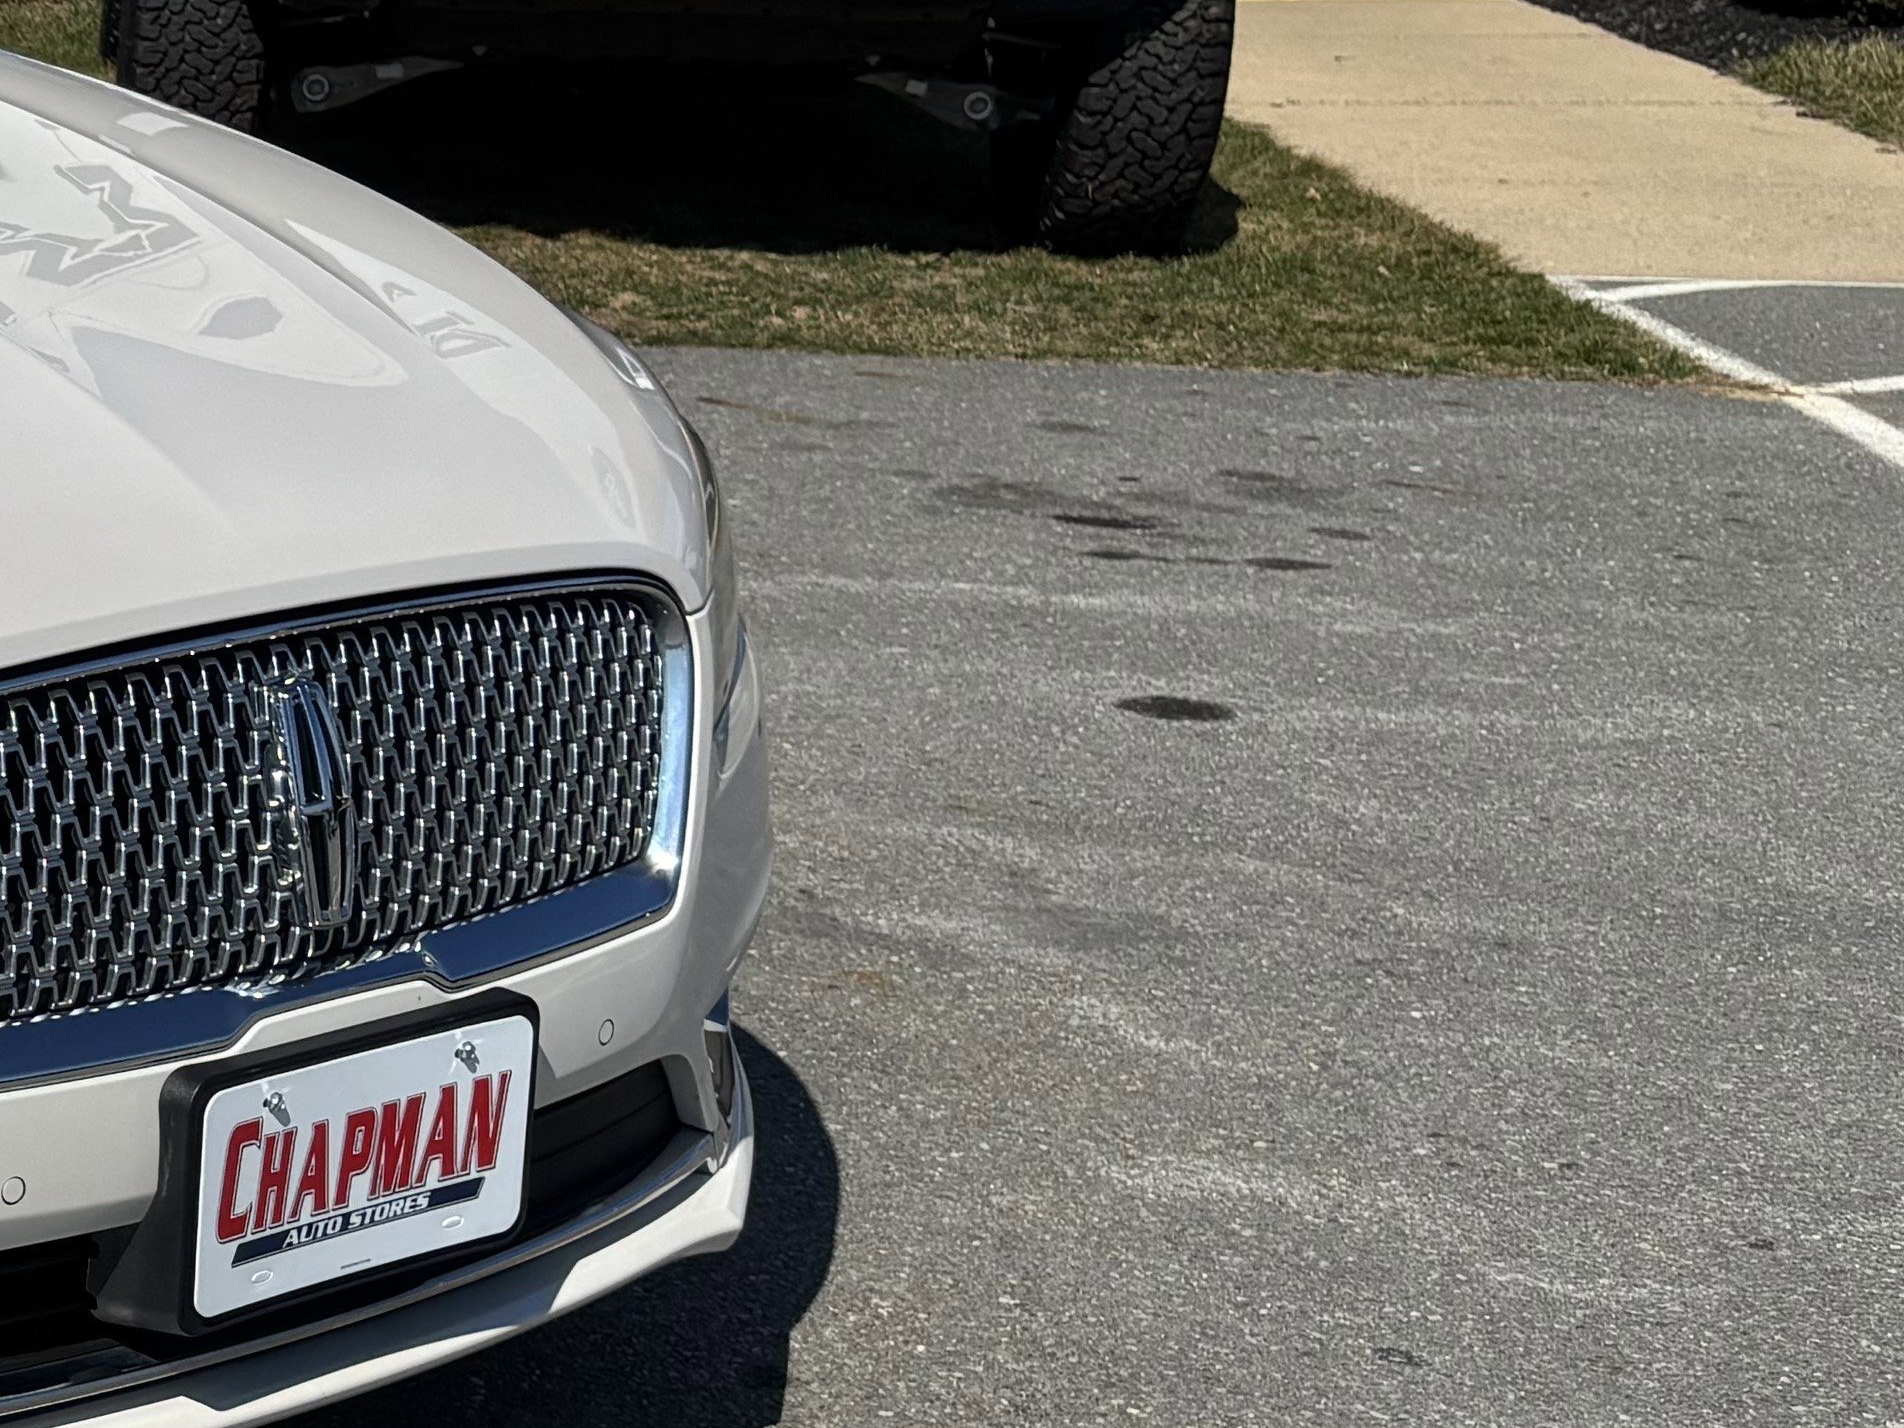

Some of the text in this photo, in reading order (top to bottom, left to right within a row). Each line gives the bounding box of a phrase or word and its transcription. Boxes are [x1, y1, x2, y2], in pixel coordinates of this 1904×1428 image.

[215, 1070, 512, 1244] CHAPMAN
[282, 1191, 432, 1249] AUTO STORES
